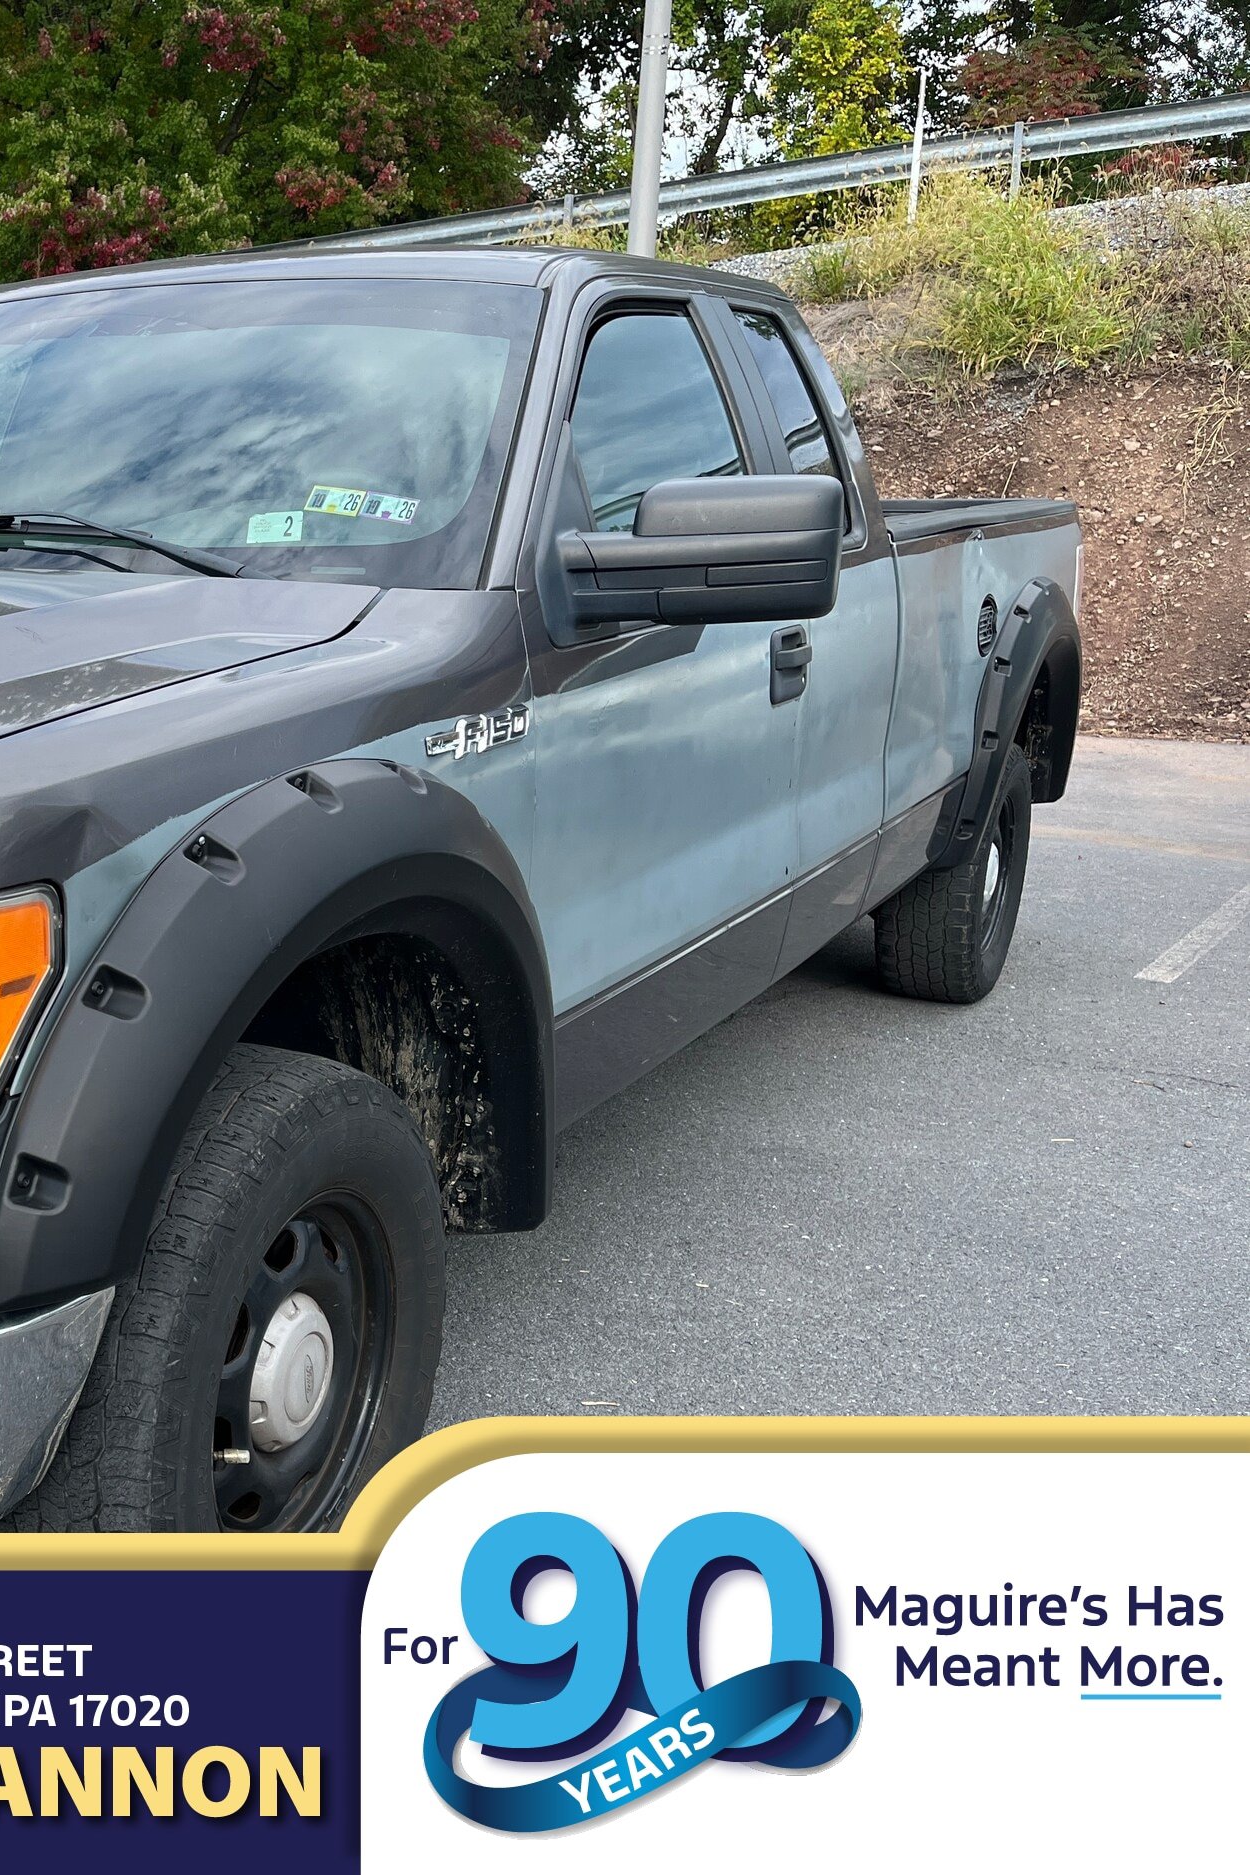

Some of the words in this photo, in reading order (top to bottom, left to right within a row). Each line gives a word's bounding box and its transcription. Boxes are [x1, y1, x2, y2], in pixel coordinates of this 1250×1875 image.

[343, 493, 362, 511] 26
[398, 501, 416, 519] 26
[283, 515, 293, 537] 2
